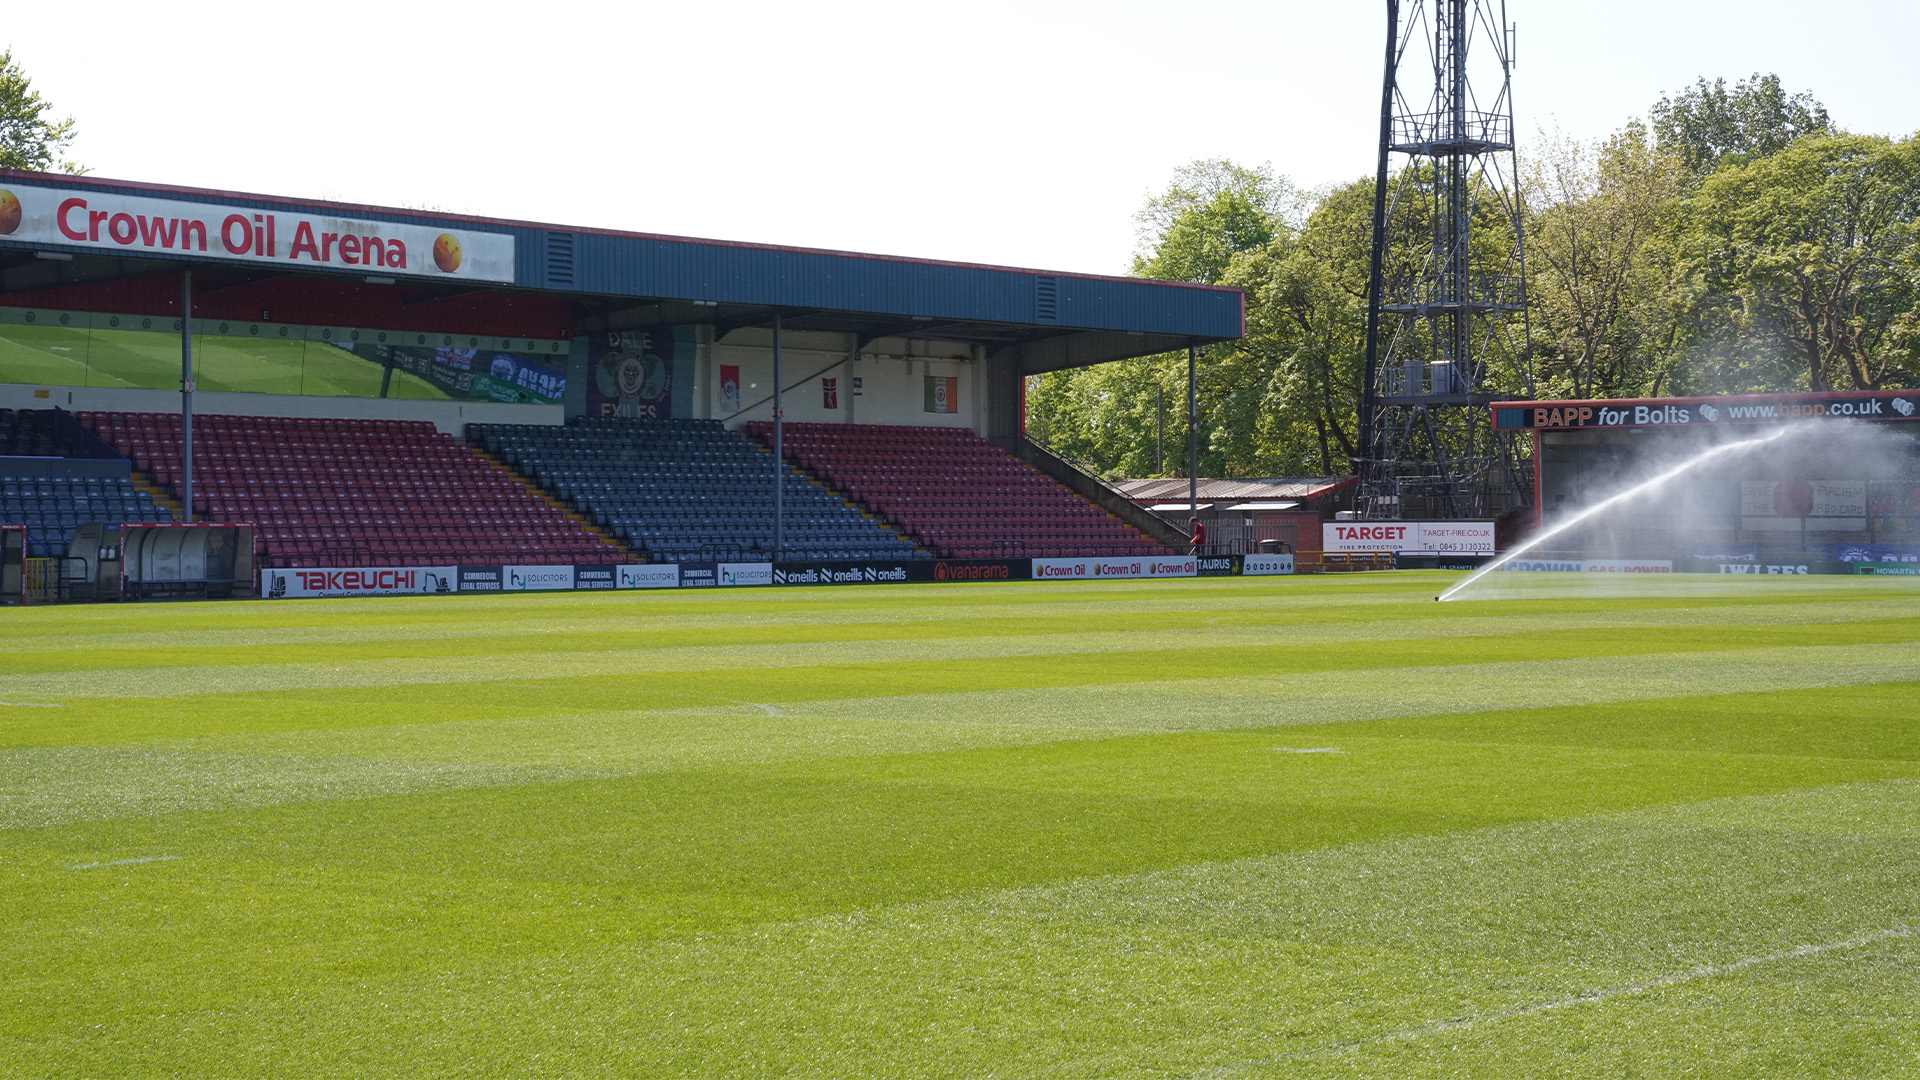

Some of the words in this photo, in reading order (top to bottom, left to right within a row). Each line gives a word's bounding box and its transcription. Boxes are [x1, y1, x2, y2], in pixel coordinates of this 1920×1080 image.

[56, 197, 208, 251] Crown
[221, 213, 276, 257] Oil
[289, 220, 407, 269] Arena
[263, 310, 270, 320] E
[607, 331, 653, 350] DALE
[600, 402, 657, 419] EXILES
[1533, 407, 1593, 427] BAPP
[1598, 406, 1630, 426] for
[1635, 405, 1690, 425] Bolts
[1728, 398, 1883, 419] www.bapp.co.uk
[1335, 526, 1407, 540] TARGET
[1422, 529, 1491, 537] TARGET-FIRE.CO.UK
[1044, 564, 1072, 576] Crown
[1074, 563, 1086, 576] Oil
[1102, 564, 1129, 575] Crown
[1130, 562, 1141, 574] Oil
[1157, 562, 1183, 574] Crown
[1184, 561, 1195, 573] Oil
[1197, 559, 1230, 570] TAURUS
[463, 571, 497, 580] COMMERCIAL
[510, 568, 527, 590] hy
[527, 573, 568, 583] SOLICITORS
[579, 571, 611, 579] COMMERCIAL
[621, 568, 636, 588] hy
[636, 572, 675, 581] SOLICITORS
[684, 569, 713, 577] COMMERCIAL
[722, 566, 736, 585] hy
[736, 570, 772, 579] SOLICITORS
[949, 565, 1009, 580] vanarama
[295, 570, 416, 591] TAKEUCHI
[460, 582, 476, 590] LEGAL
[476, 581, 500, 590] SERVICES
[577, 581, 592, 589] LEGAL
[592, 580, 614, 589] SERVICES
